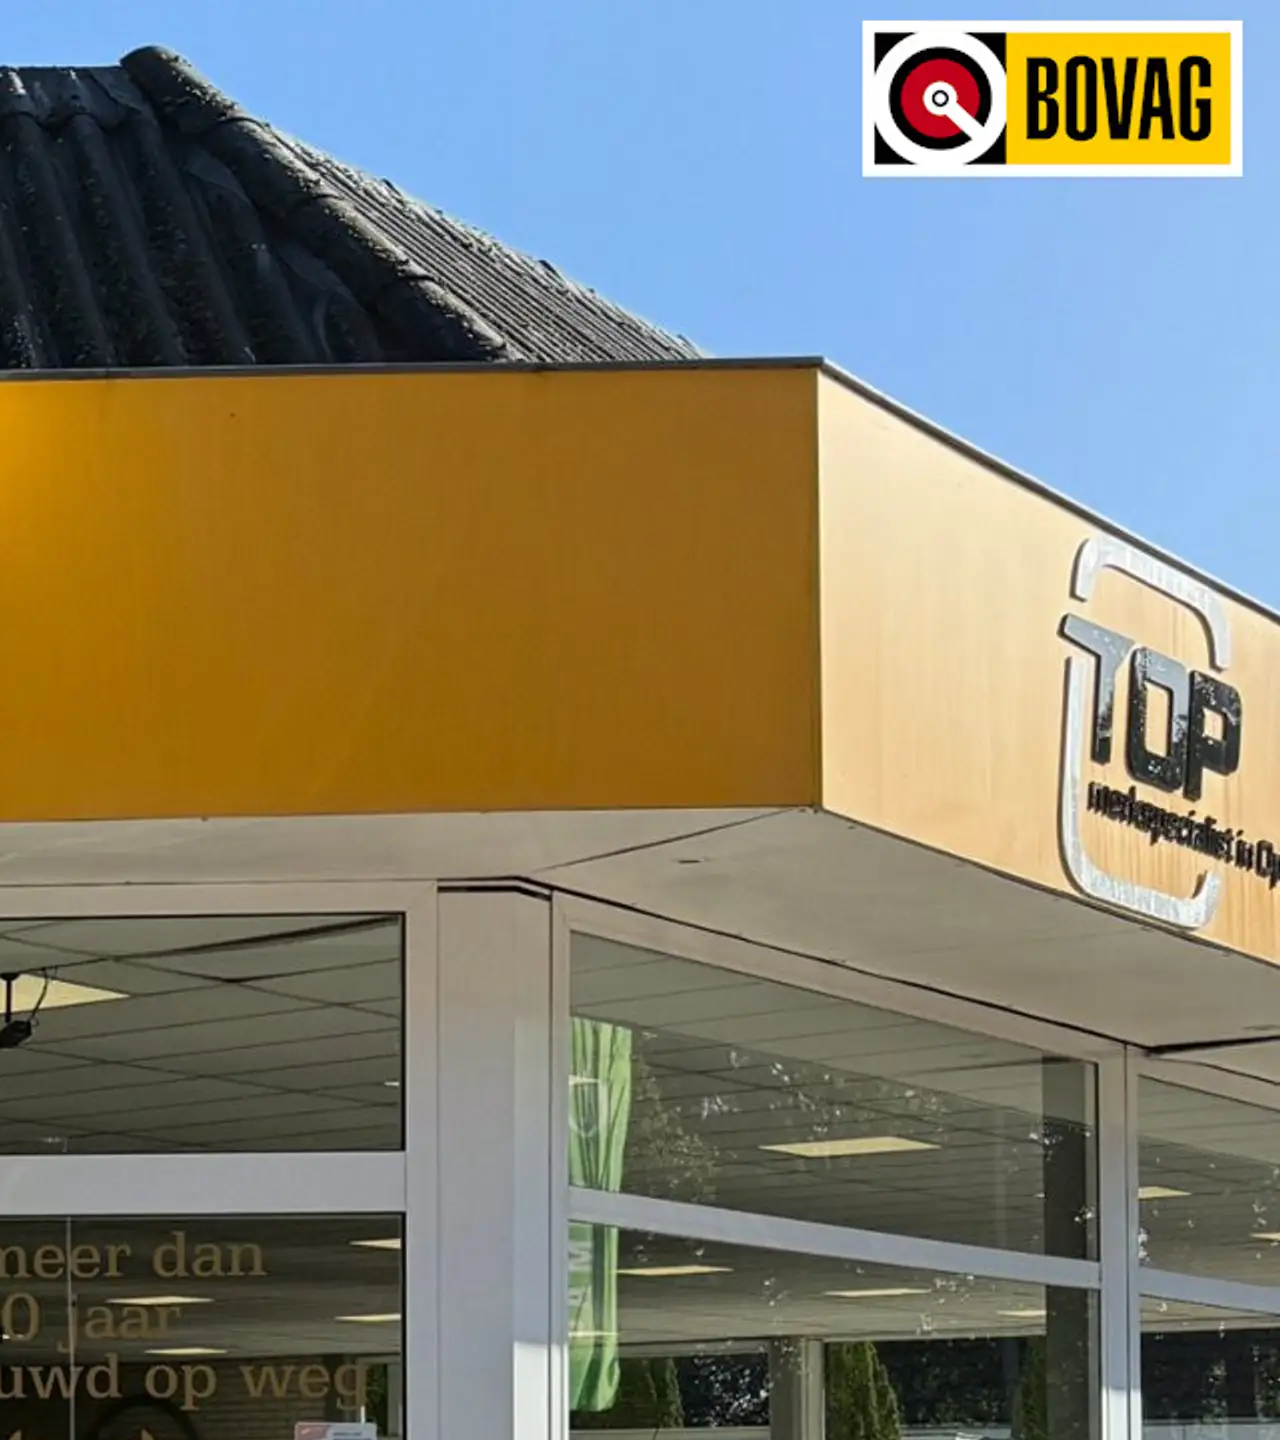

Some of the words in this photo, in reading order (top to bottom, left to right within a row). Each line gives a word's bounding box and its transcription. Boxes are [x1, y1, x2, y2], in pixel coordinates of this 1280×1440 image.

[1056, 613, 1242, 802] TOP
[152, 1232, 268, 1279] dan
[57, 1292, 181, 1353] jaar
[144, 1364, 217, 1411] op
[241, 1362, 369, 1409] weg
